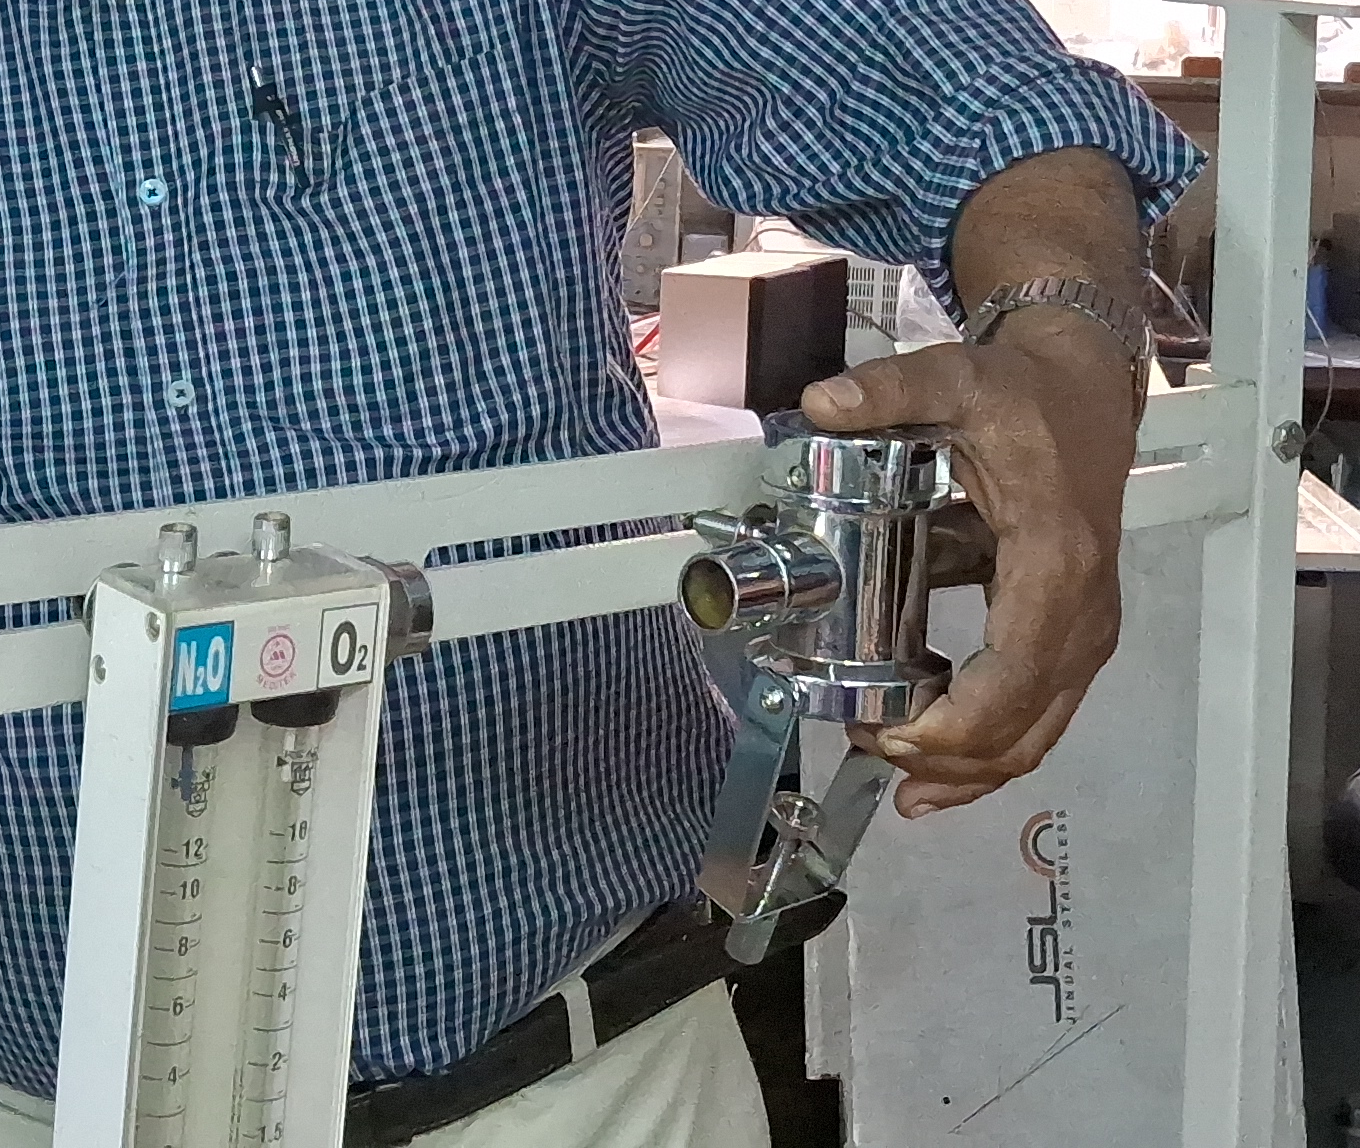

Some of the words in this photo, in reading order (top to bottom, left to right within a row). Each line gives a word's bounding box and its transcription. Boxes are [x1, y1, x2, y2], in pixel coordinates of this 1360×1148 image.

[182, 837, 204, 860] 12
[1055, 809, 1074, 930] STAINLESS
[179, 878, 200, 900] 10
[287, 875, 297, 896] 8
[177, 936, 189, 956] 8
[282, 928, 293, 949] 6
[277, 981, 288, 1001] 4
[1063, 945, 1077, 1025] JINDAL
[172, 996, 184, 1016] 6
[270, 1051, 283, 1071] 2
[167, 1065, 178, 1085] 4
